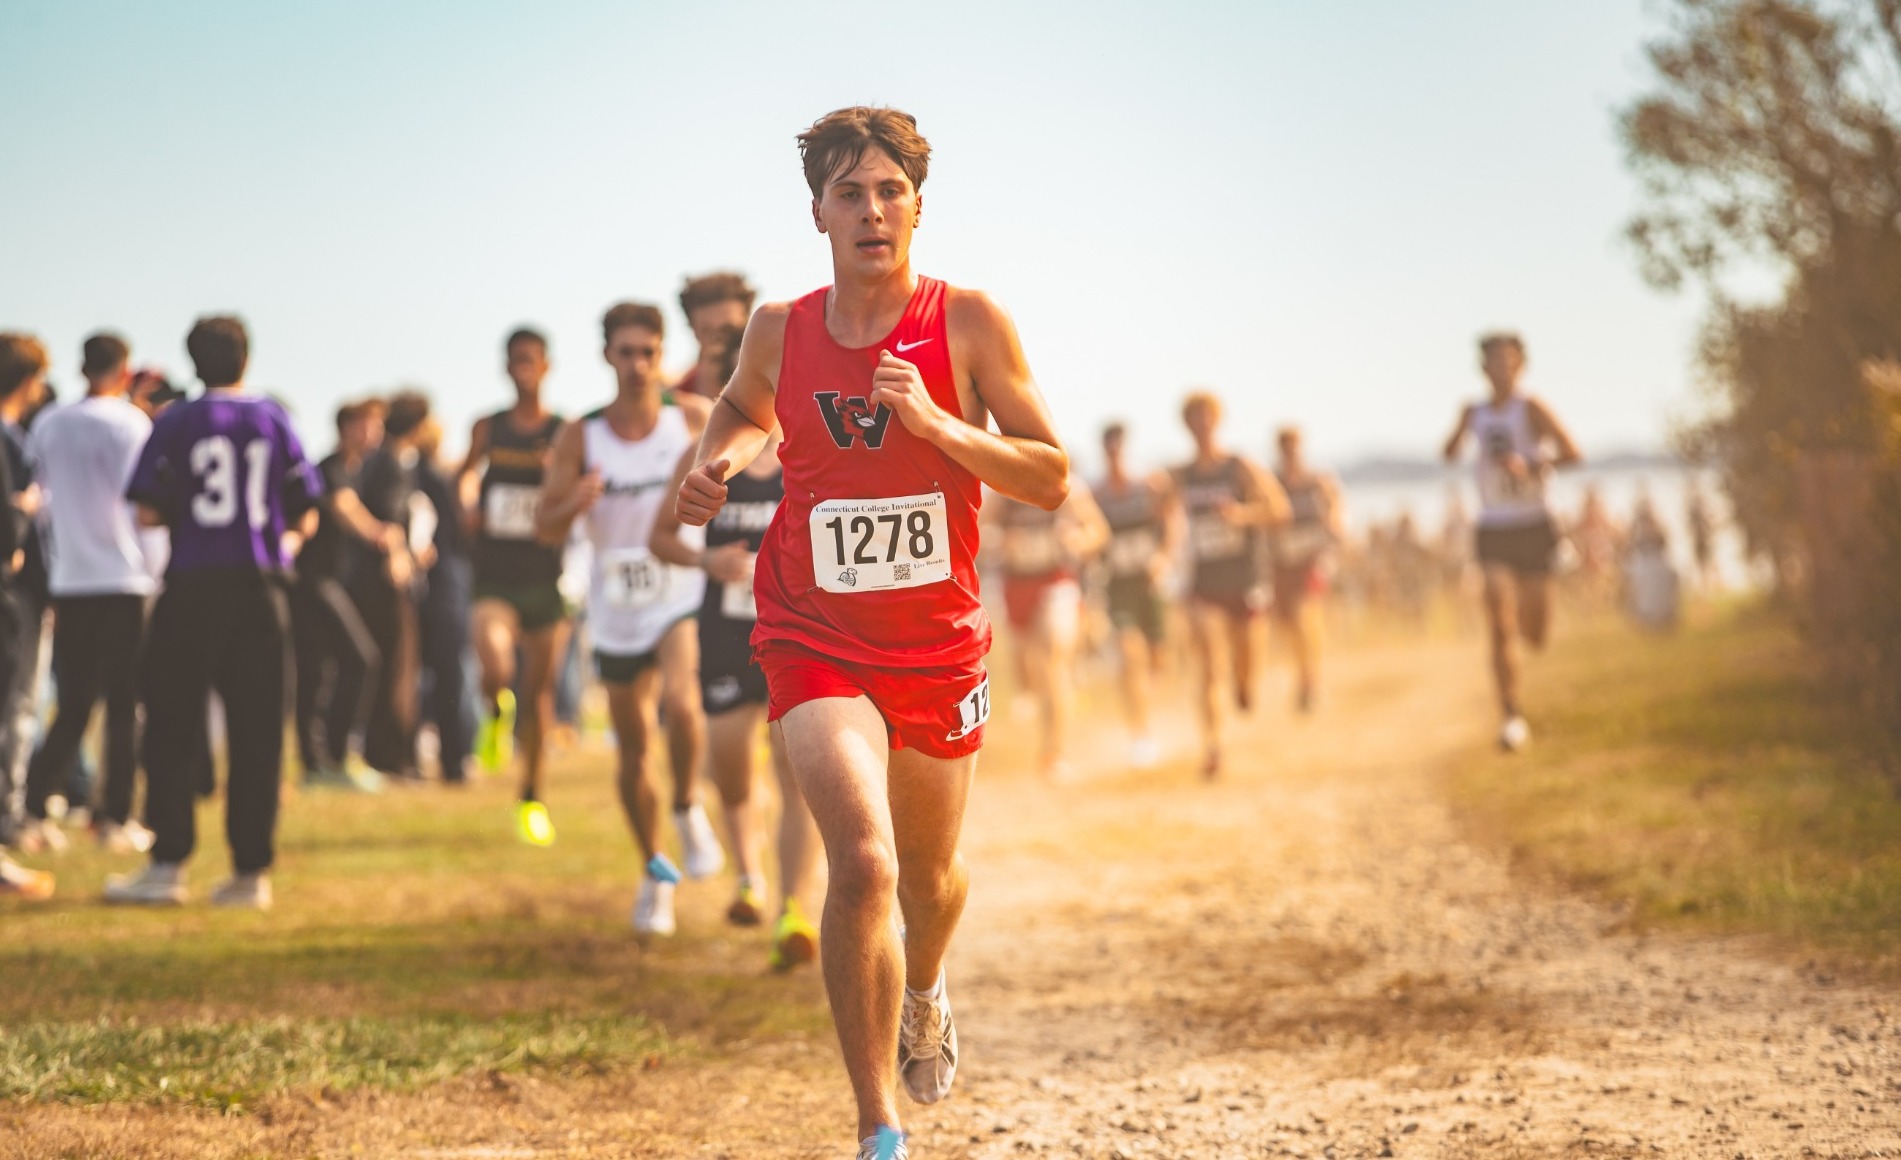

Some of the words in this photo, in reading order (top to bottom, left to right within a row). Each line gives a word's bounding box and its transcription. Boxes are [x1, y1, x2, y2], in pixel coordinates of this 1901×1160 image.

[813, 390, 894, 449] W
[190, 434, 270, 530] 31
[815, 504, 859, 513] Connecticut
[861, 503, 890, 513] College
[891, 499, 937, 511] Invitational
[825, 510, 934, 566] 1278
[926, 558, 945, 566] Results
